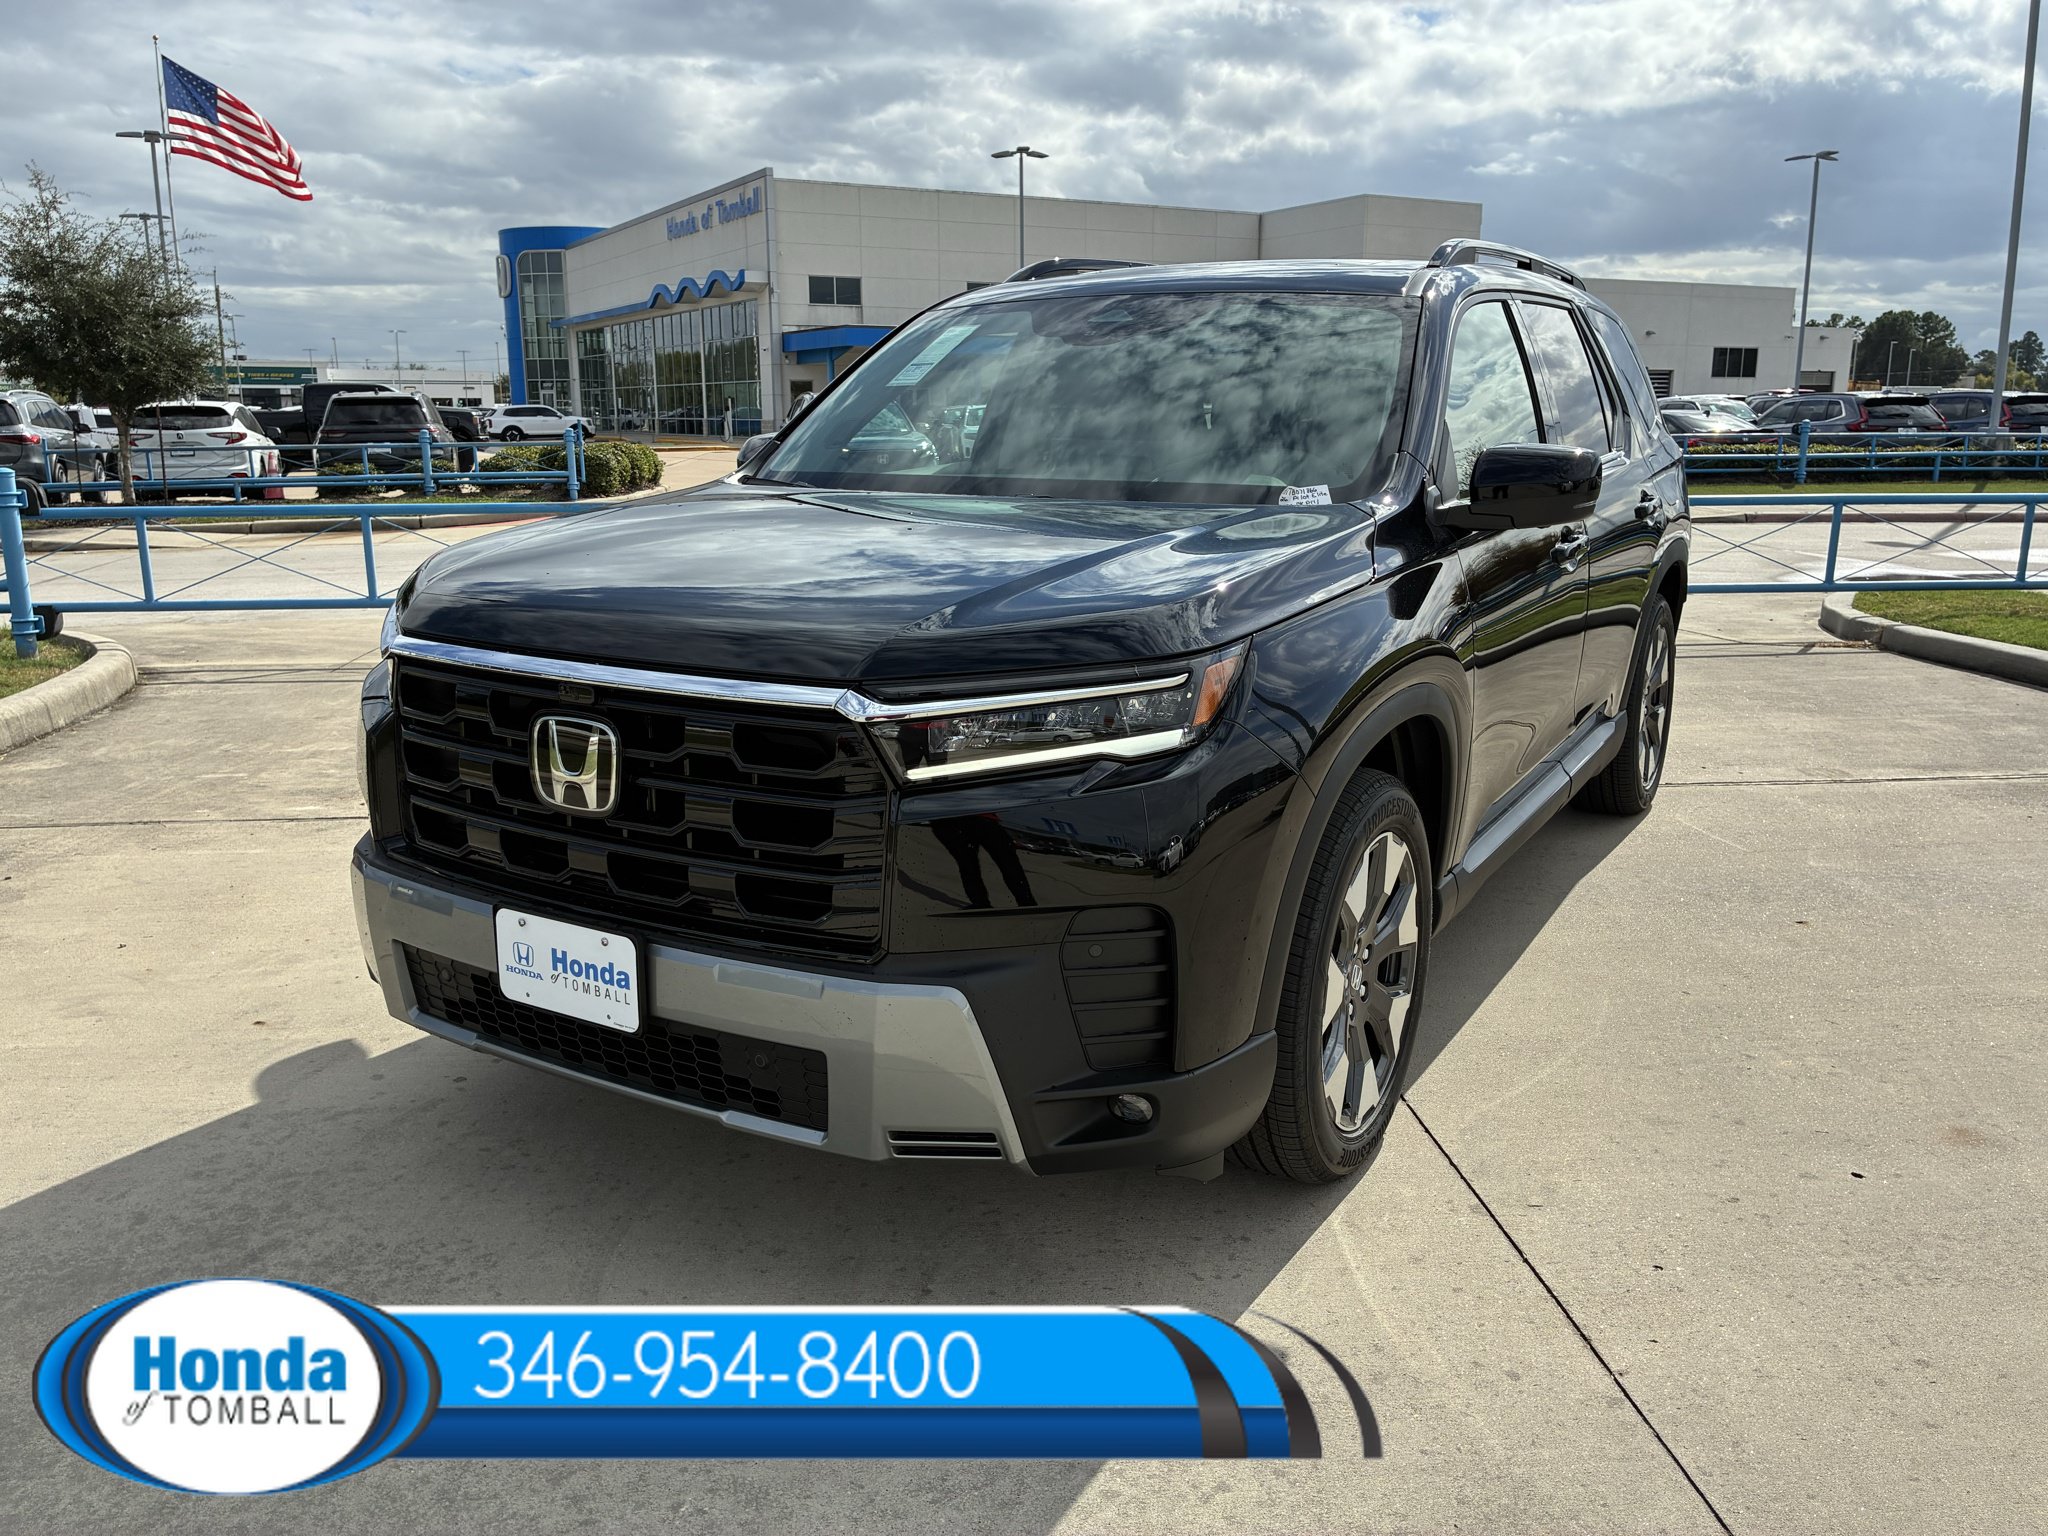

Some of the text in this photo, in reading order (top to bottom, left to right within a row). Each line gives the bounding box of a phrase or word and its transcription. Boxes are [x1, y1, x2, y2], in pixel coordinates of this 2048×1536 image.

[666, 186, 762, 241] Honda of Tomball
[506, 964, 544, 981] HONDA
[551, 947, 631, 990] Honda
[550, 972, 631, 1006] of TOMBALL
